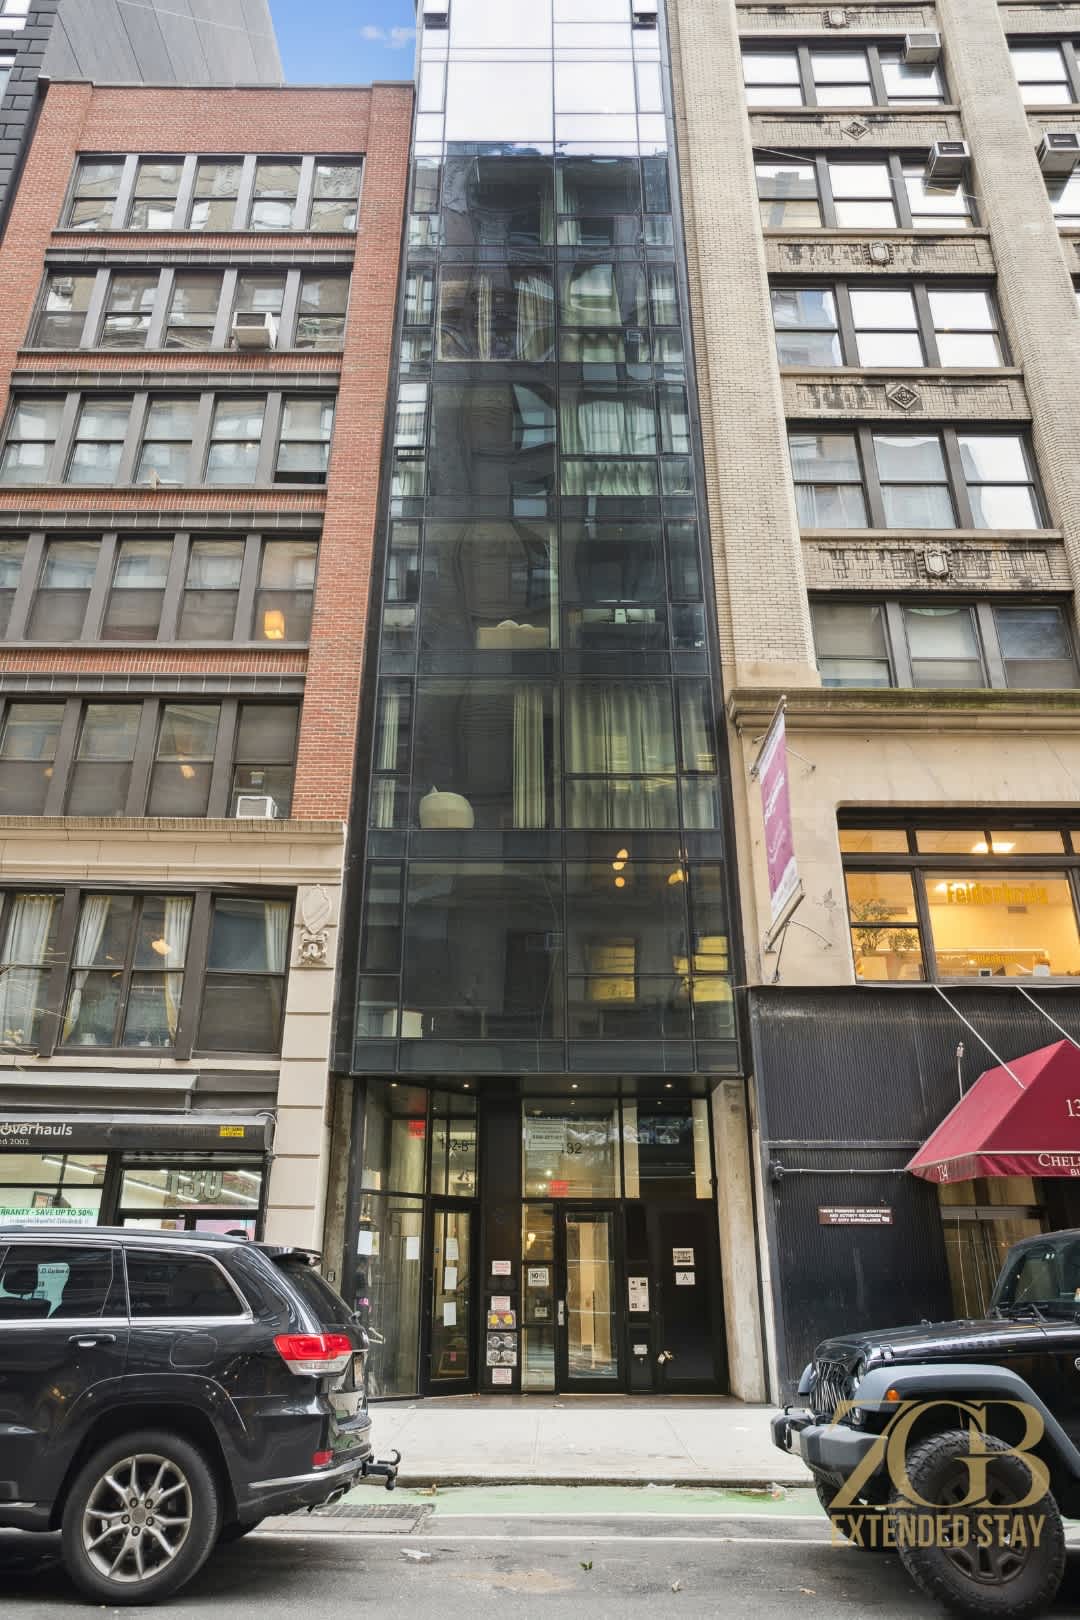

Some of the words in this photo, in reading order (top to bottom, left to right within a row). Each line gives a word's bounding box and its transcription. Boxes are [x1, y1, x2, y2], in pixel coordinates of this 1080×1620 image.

[35, 1208, 54, 1216] SAVE
[55, 1208, 66, 1216] UP
[66, 1208, 77, 1216] TO
